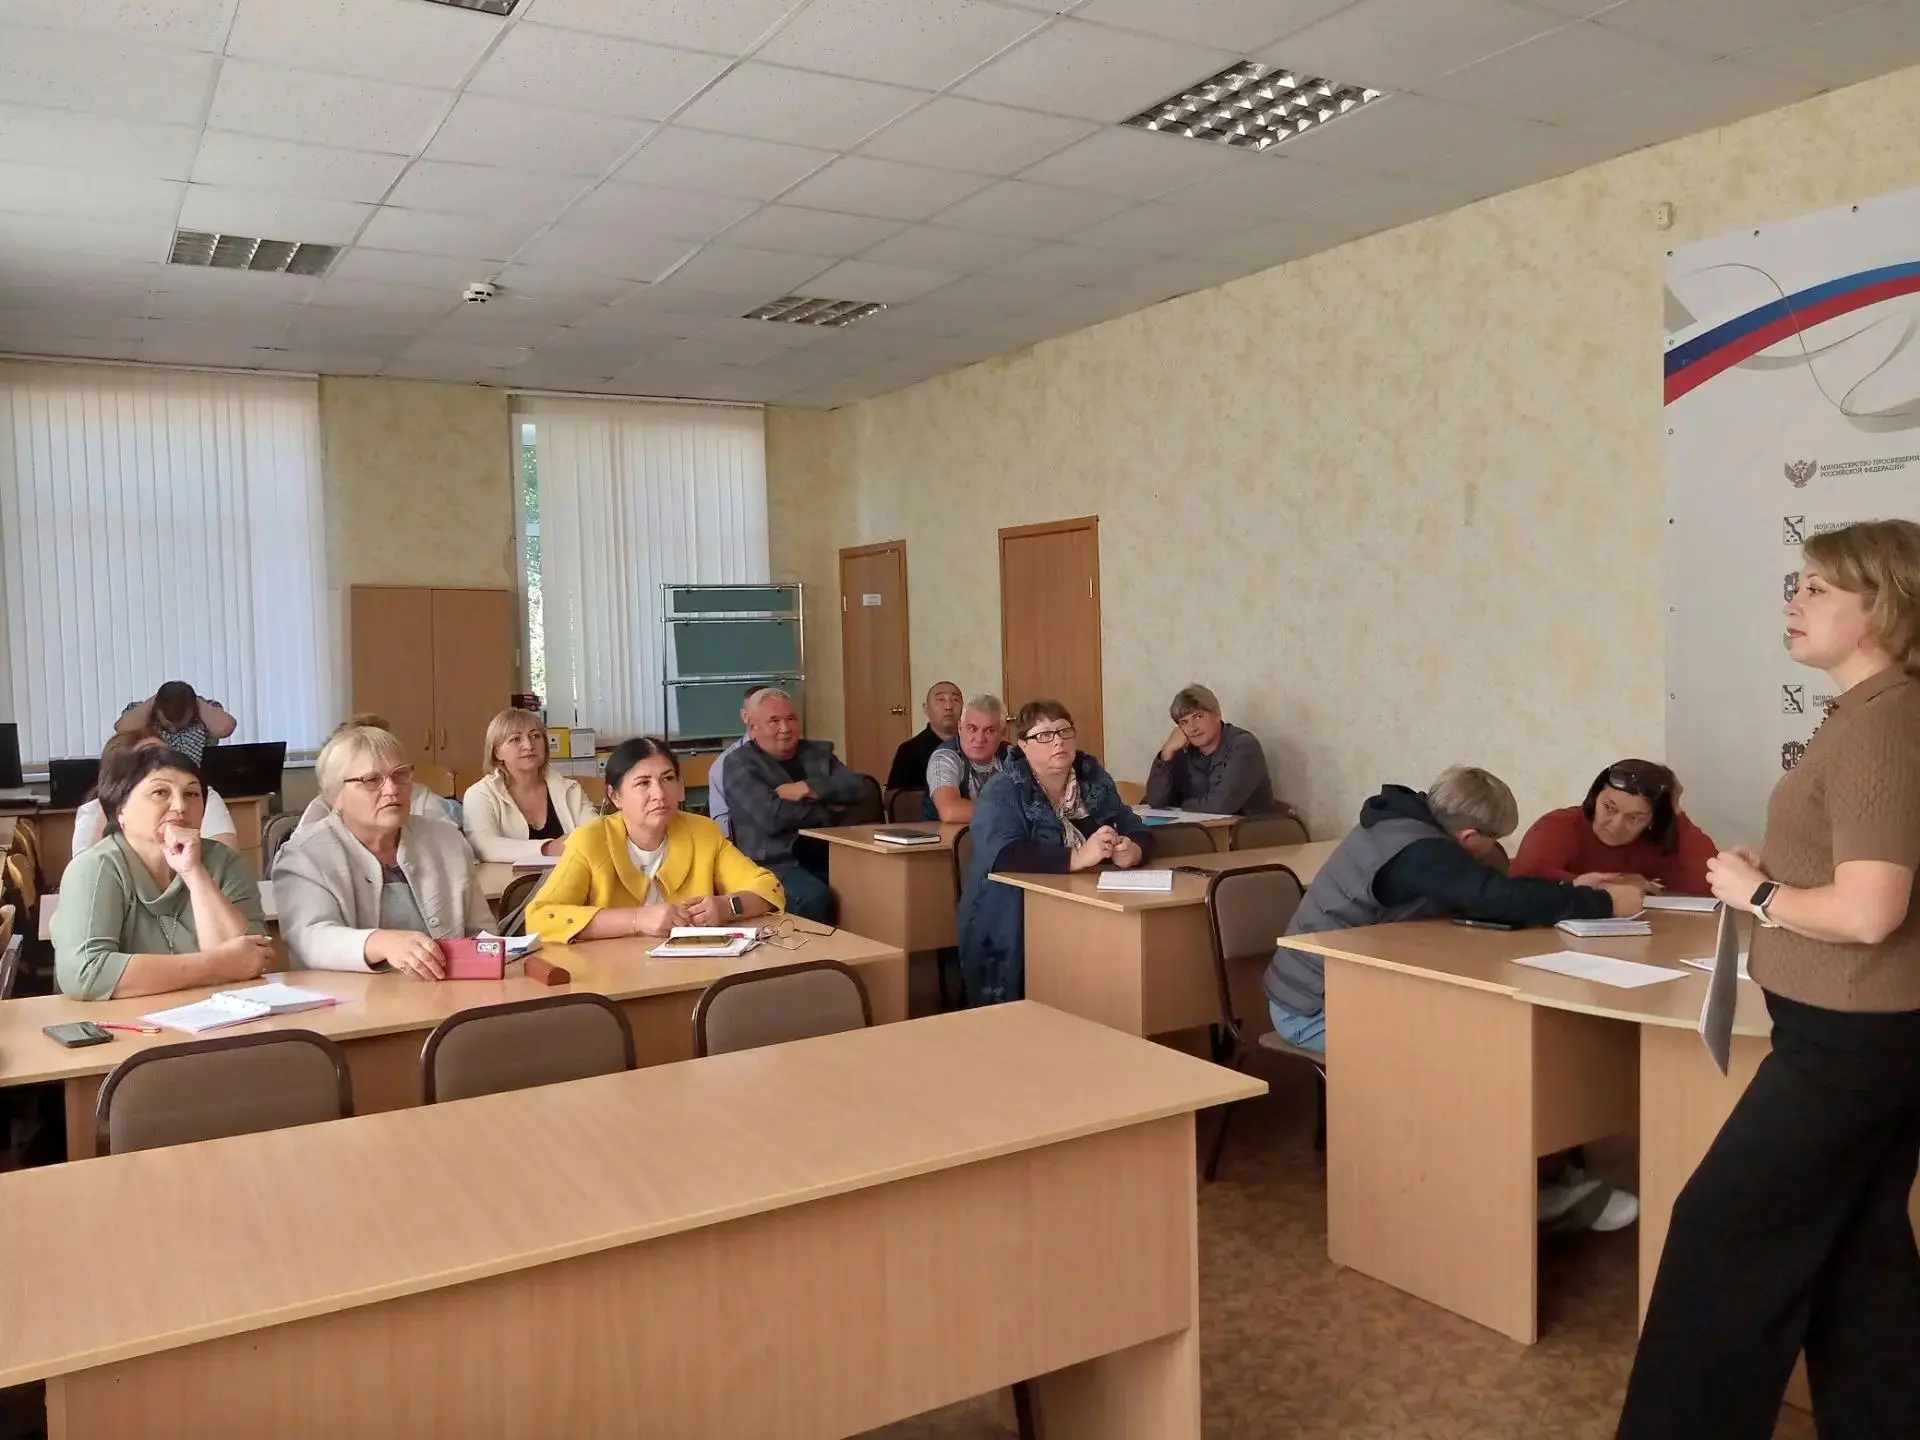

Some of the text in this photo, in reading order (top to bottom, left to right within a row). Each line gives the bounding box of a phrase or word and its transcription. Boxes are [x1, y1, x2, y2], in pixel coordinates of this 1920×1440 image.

[1820, 455, 1920, 472] МИНИСТЕРСТВО ПРОСВЕЩЕНИ
[1820, 464, 1906, 478] РОССИЙСКОЙ ФЕДЕРАЦИИ
